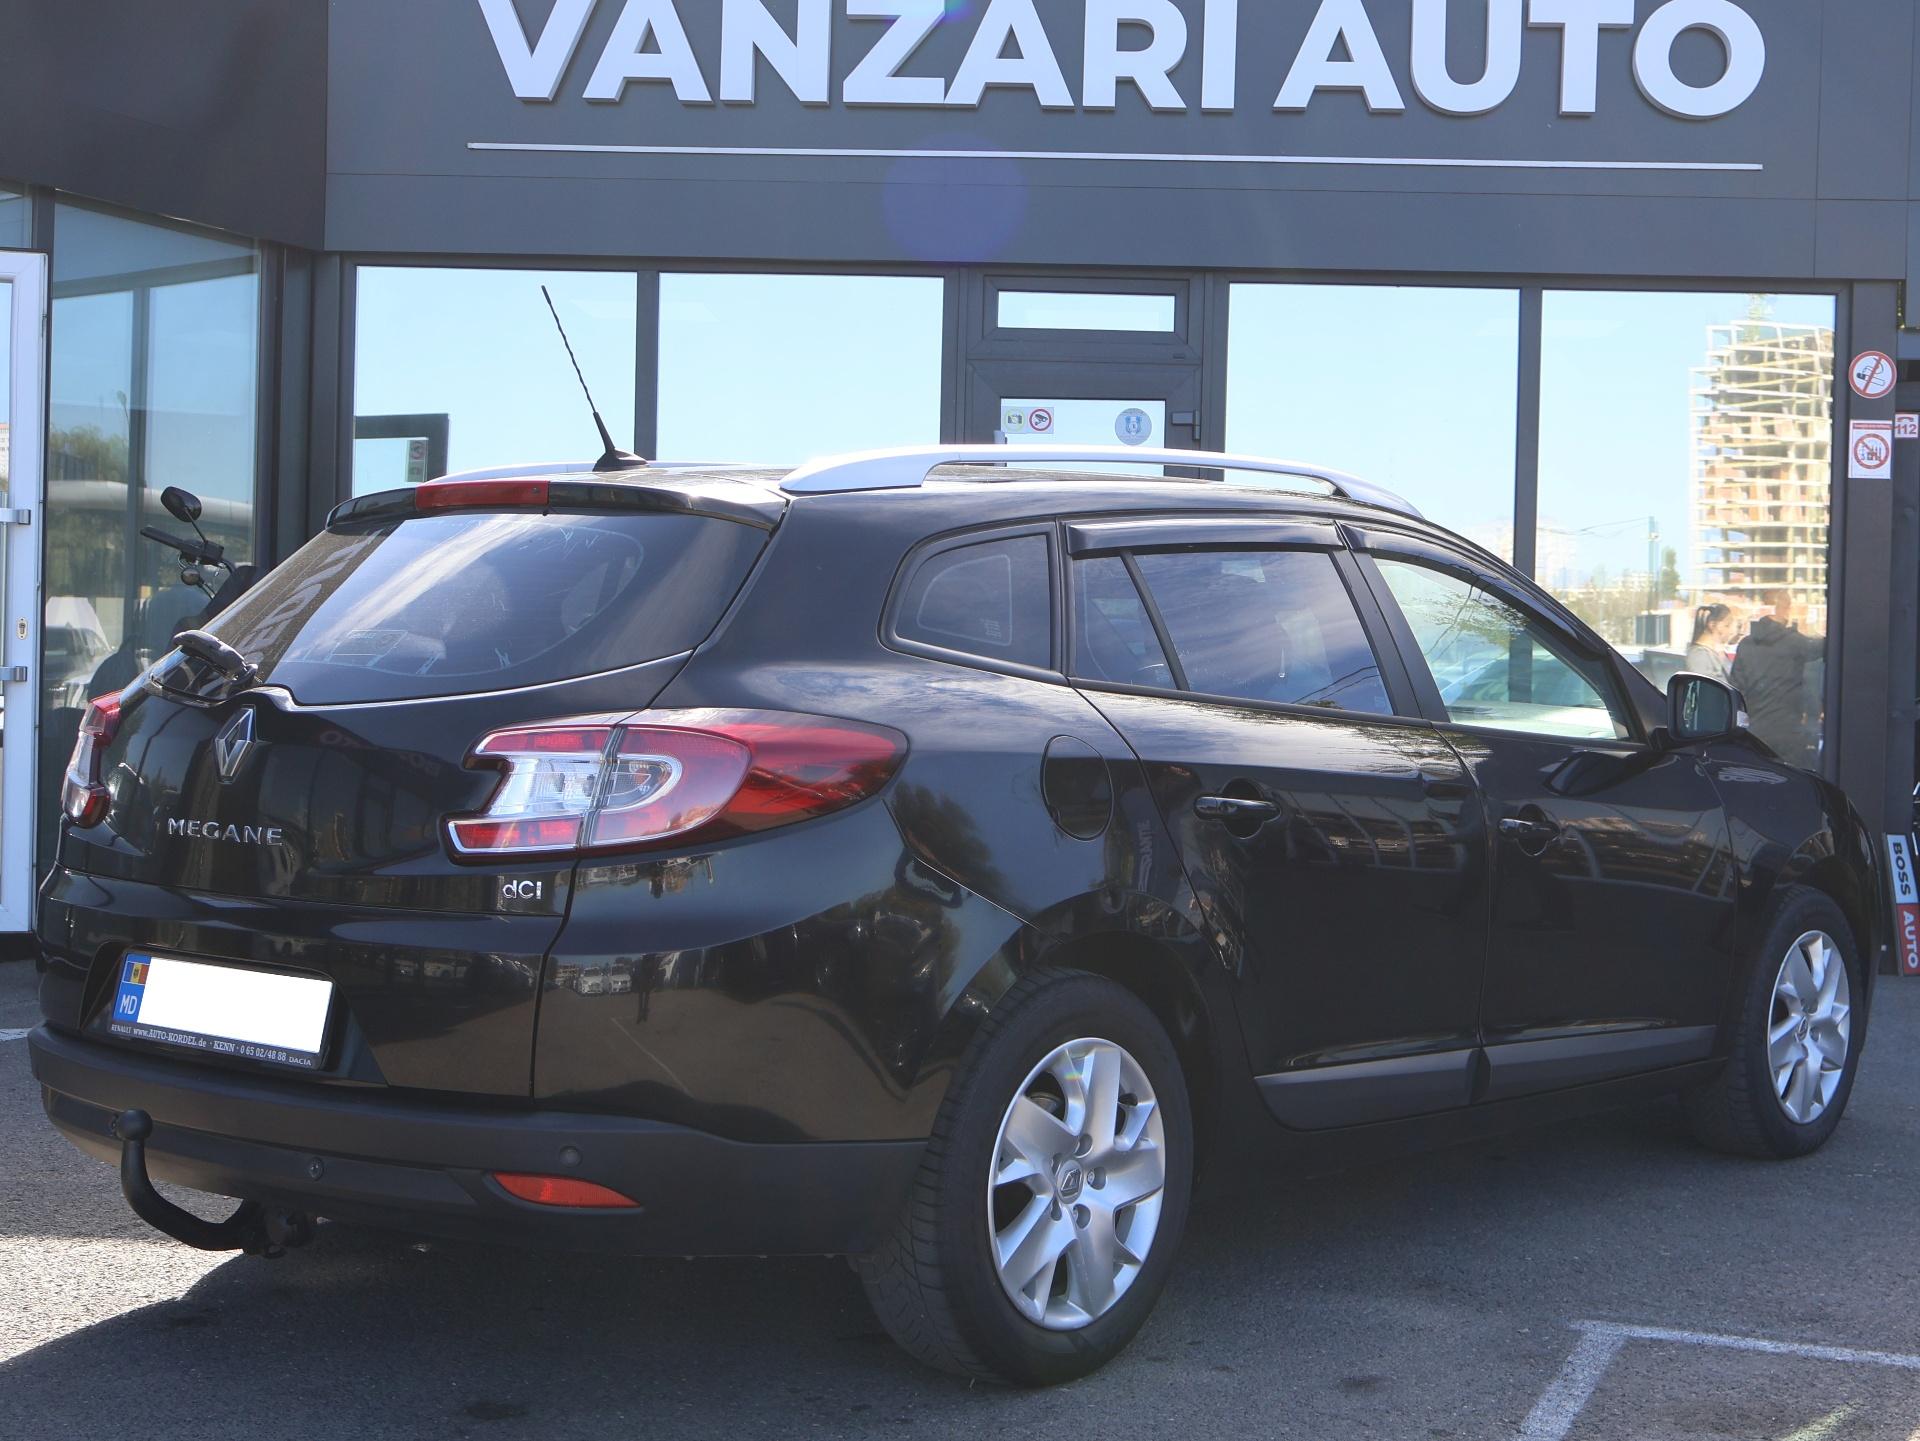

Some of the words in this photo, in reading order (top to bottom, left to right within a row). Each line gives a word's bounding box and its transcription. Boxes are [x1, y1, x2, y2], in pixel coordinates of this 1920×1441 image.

[1272, 0, 1767, 119] AUTO
[1896, 424, 1917, 435] 112
[167, 817, 283, 846] MEGANE
[1892, 841, 1911, 896] BOSS
[1903, 910, 1919, 969] AUTO
[119, 995, 138, 1015] MD
[213, 1040, 236, 1053] KENN
[255, 1049, 277, 1060] 02/48
[277, 1051, 287, 1062] 88
[288, 1056, 312, 1066] DACIA
